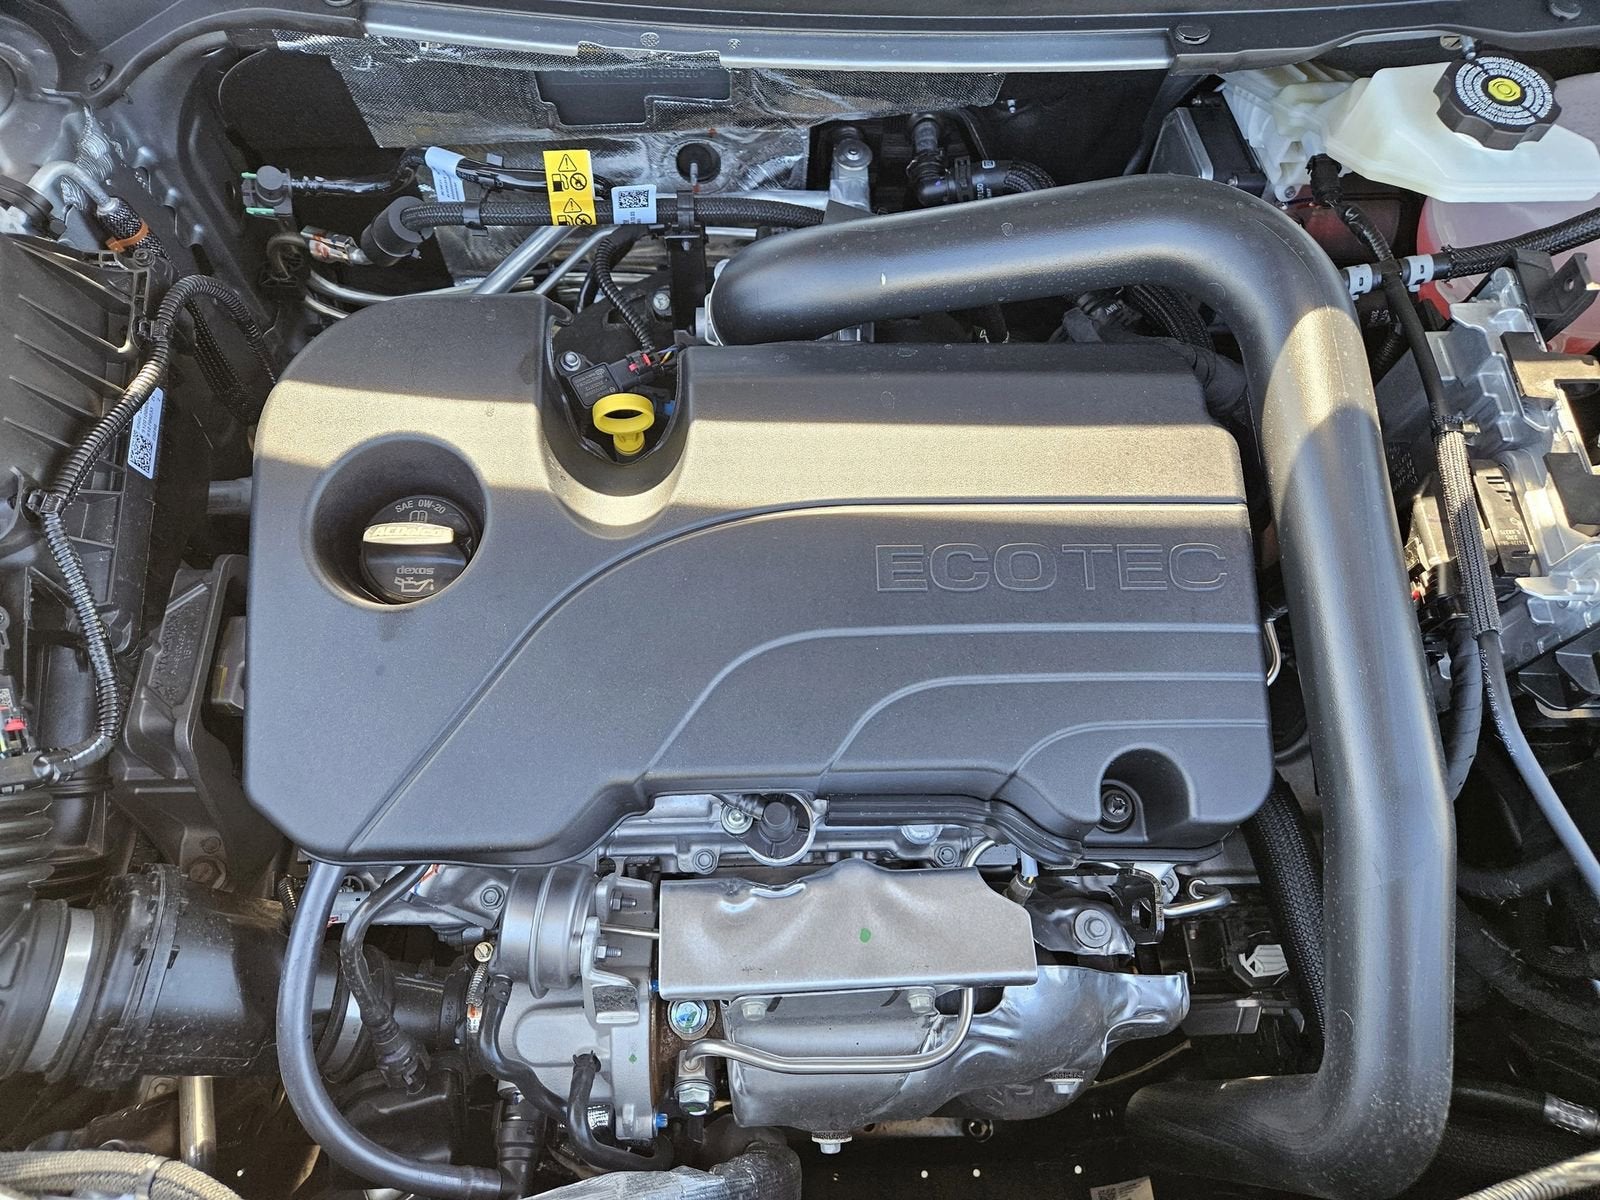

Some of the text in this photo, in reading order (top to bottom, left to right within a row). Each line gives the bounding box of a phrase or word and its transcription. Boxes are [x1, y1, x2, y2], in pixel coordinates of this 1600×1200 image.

[395, 499, 446, 514] SAE 0W-20
[396, 565, 435, 575] dexos
[875, 542, 1228, 592] ECOTEC
